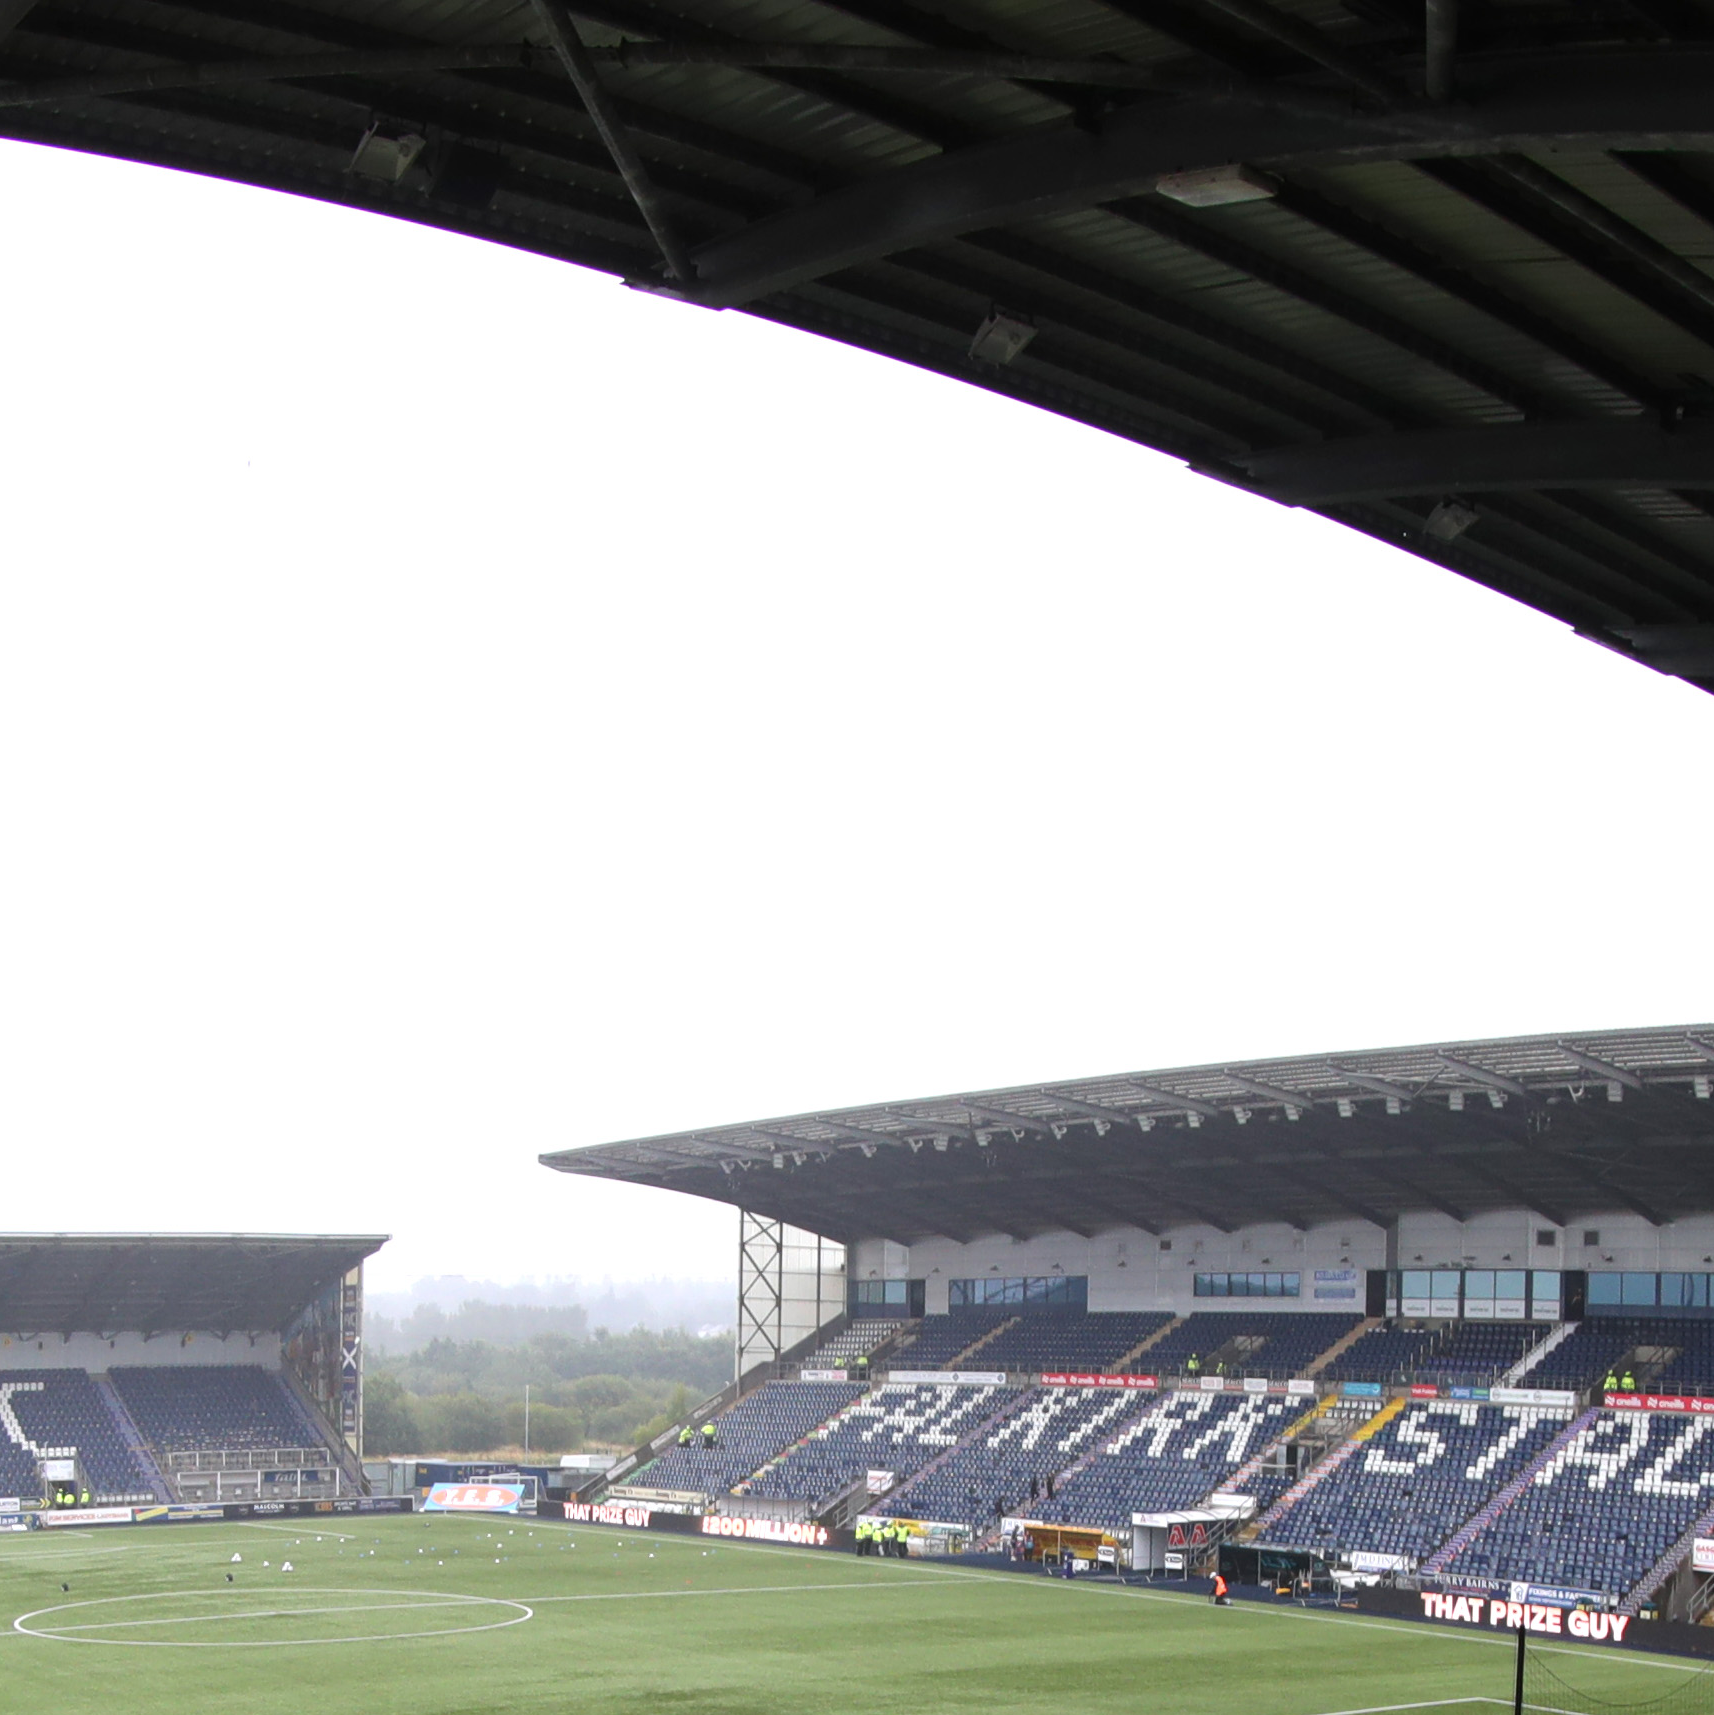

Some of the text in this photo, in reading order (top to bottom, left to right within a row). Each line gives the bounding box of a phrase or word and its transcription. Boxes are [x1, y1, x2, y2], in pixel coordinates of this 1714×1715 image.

[564, 1502, 650, 1528] THAT PRIZE GUY
[702, 1515, 745, 1537] £200
[746, 1518, 816, 1545] MILLION
[1421, 1591, 1484, 1624] THAT
[1490, 1600, 1562, 1634] PRIZE
[1568, 1610, 1630, 1642] GUY
